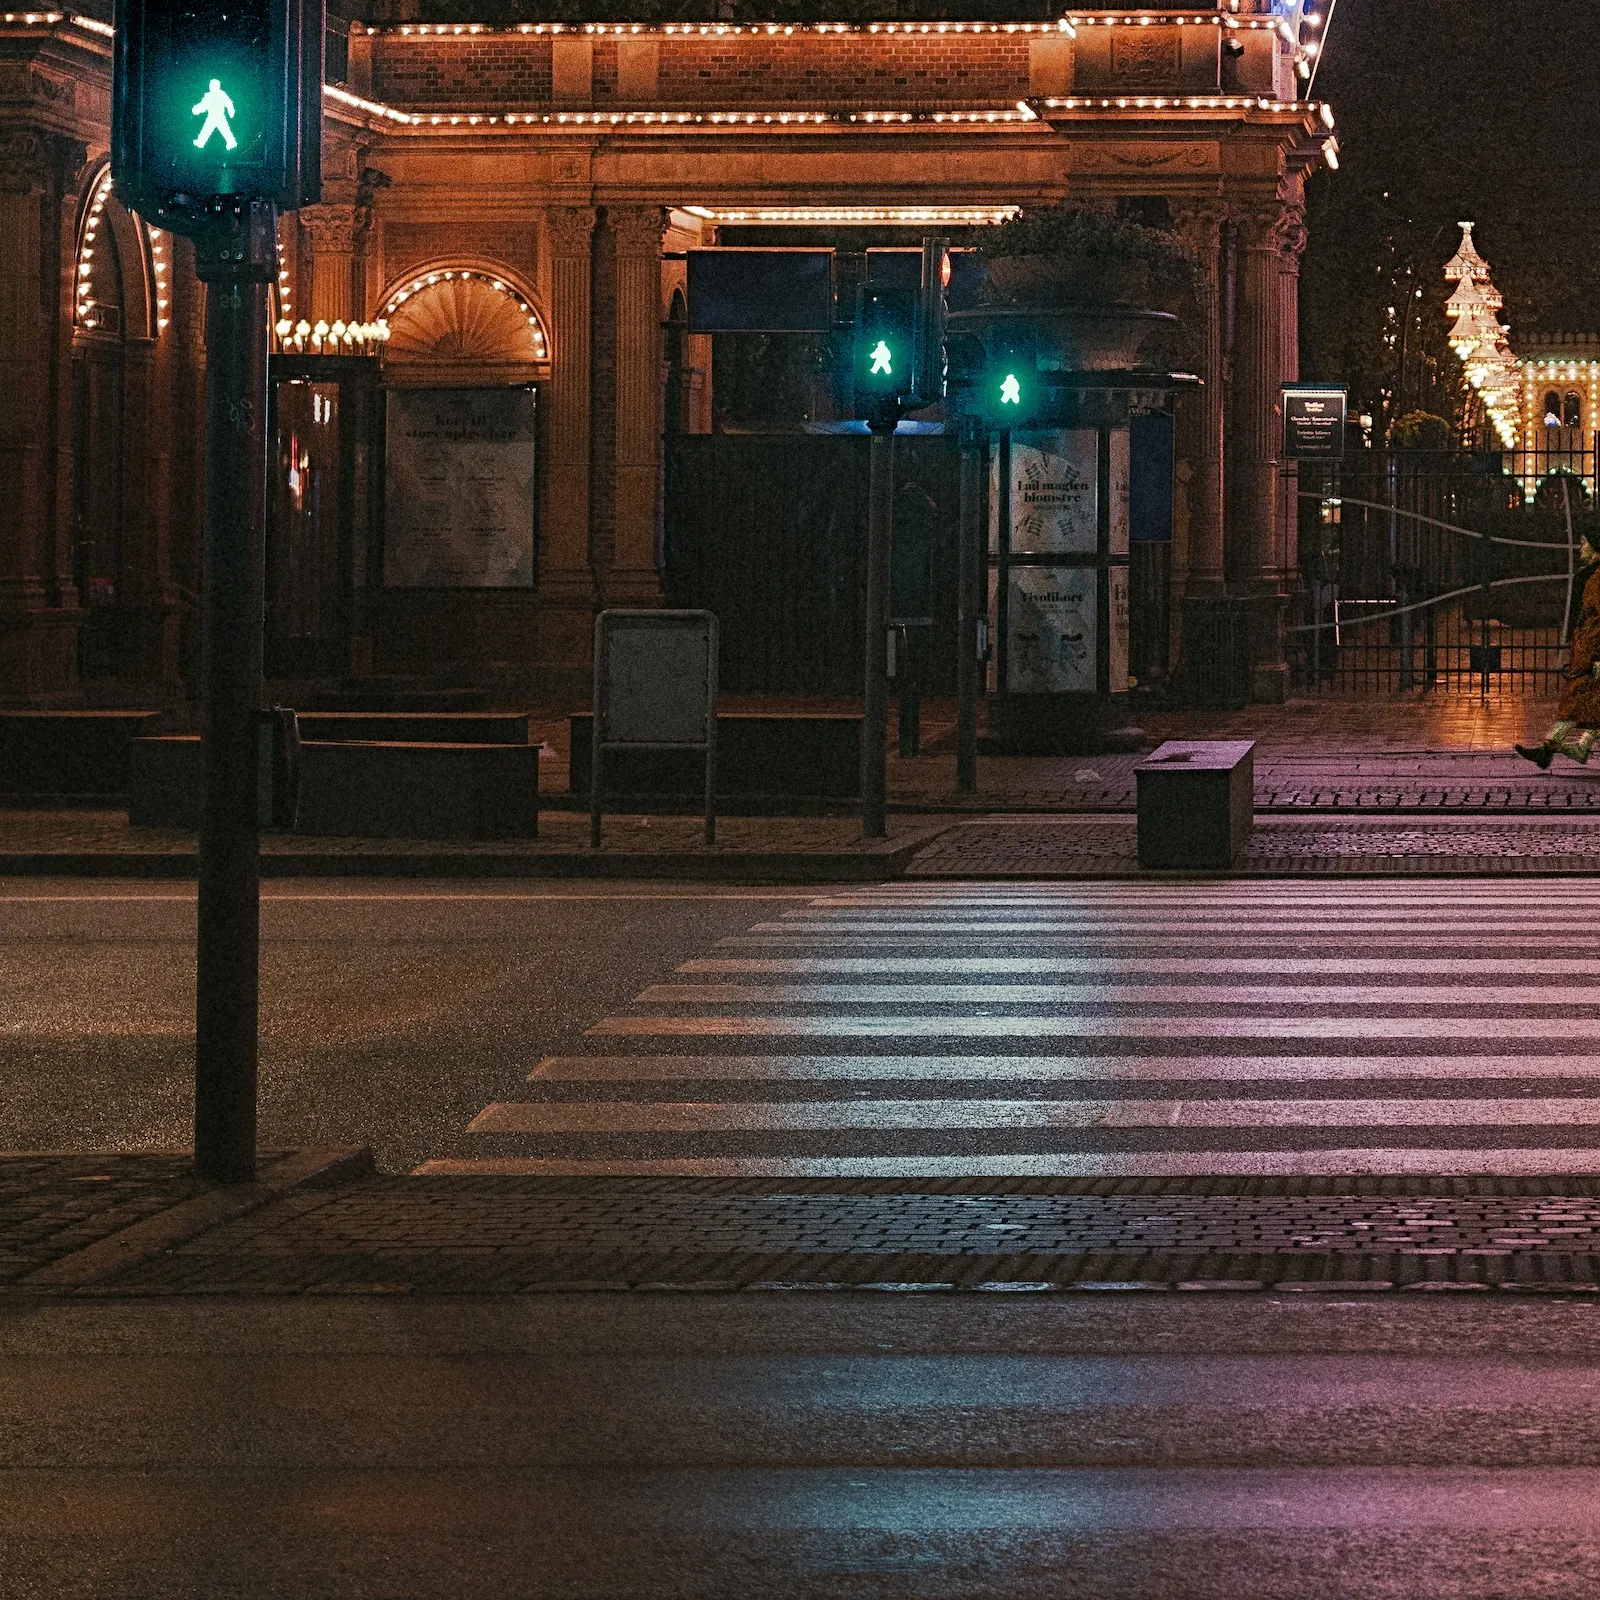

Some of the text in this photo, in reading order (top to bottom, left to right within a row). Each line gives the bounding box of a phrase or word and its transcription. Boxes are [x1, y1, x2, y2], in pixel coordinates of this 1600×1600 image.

[1017, 480, 1089, 492] Lad magien
[1024, 492, 1081, 503] blomstre
[1020, 591, 1083, 602] Tivolikort
